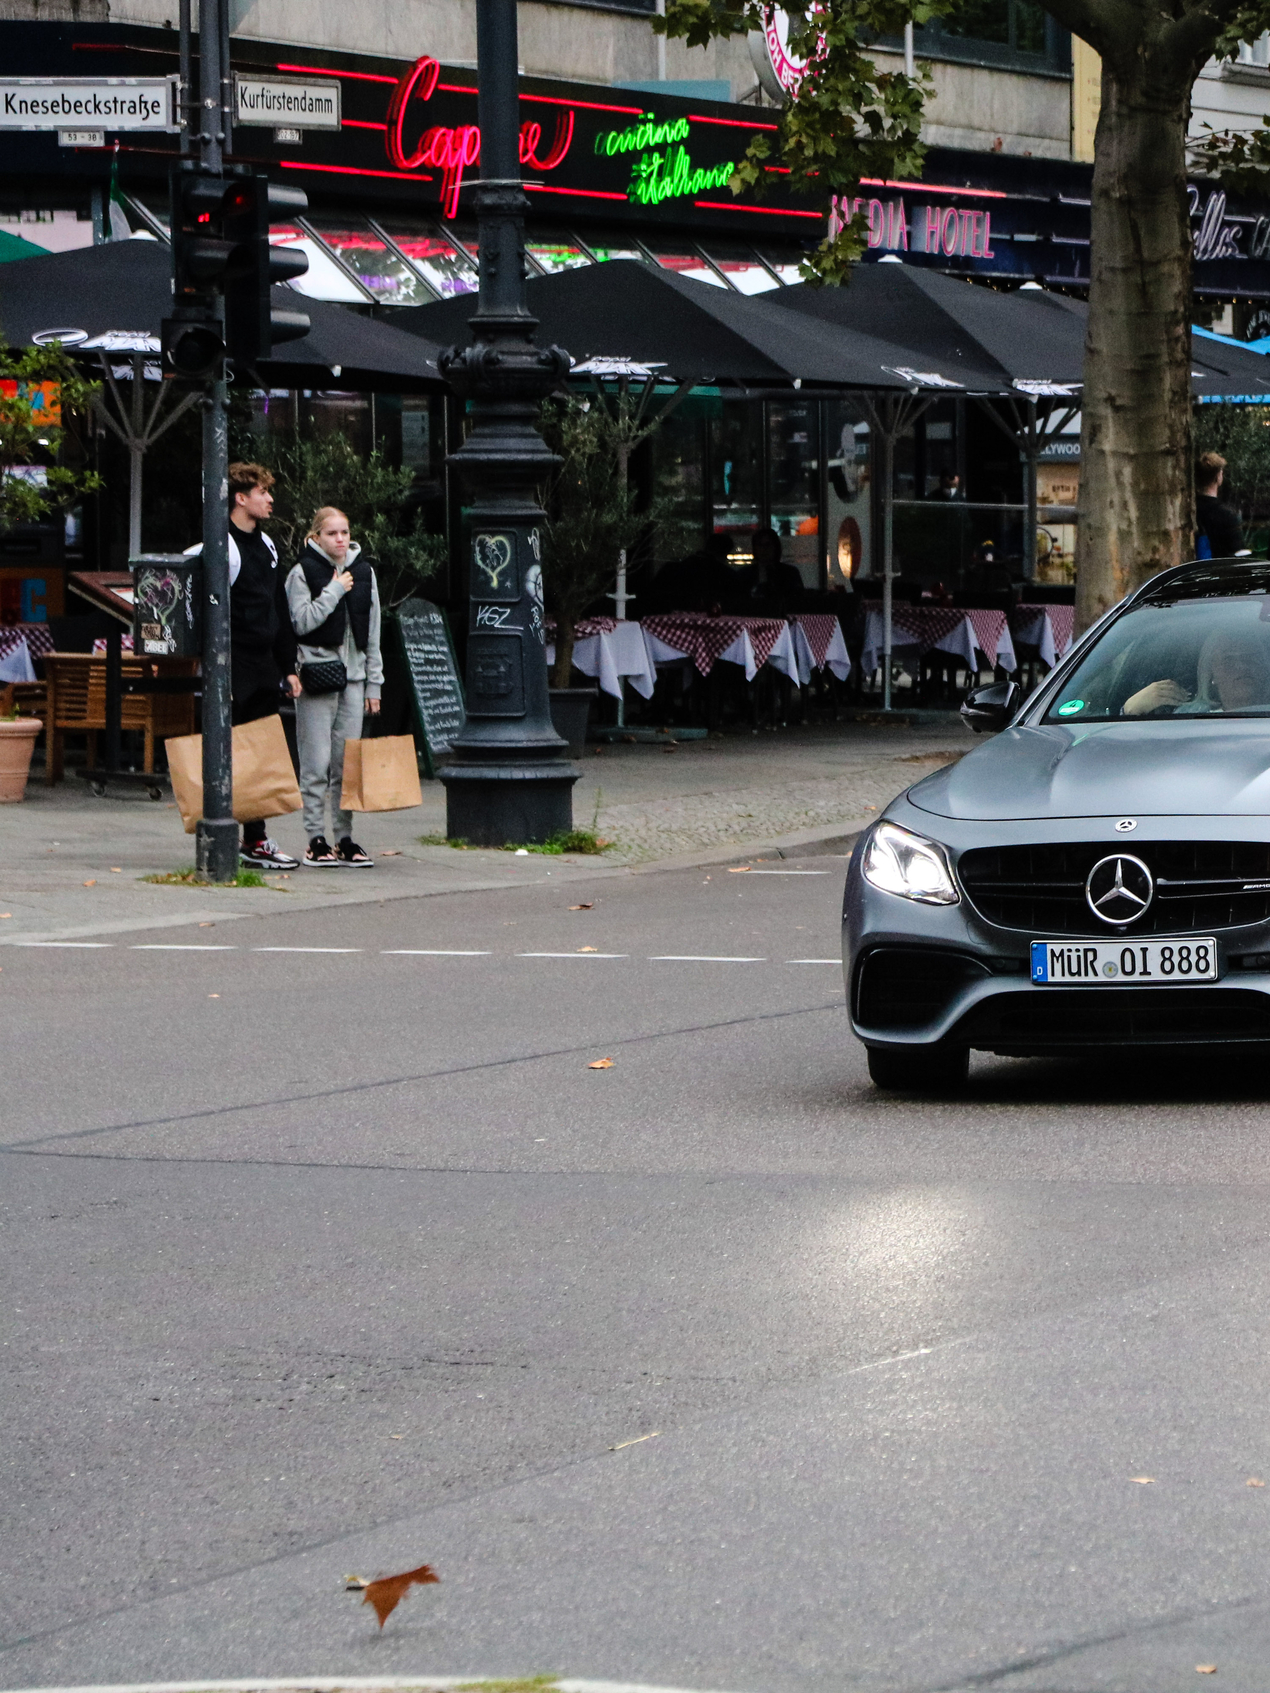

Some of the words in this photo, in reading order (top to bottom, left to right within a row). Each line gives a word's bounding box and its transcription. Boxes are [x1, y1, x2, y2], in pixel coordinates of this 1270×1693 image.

[4, 93, 161, 121] Knesebeckstraße
[240, 85, 333, 114] Kurfürstendamm
[67, 133, 77, 142] 53
[926, 205, 995, 258] HOTEL
[1036, 965, 1043, 976] D
[1160, 945, 1211, 976] 888
